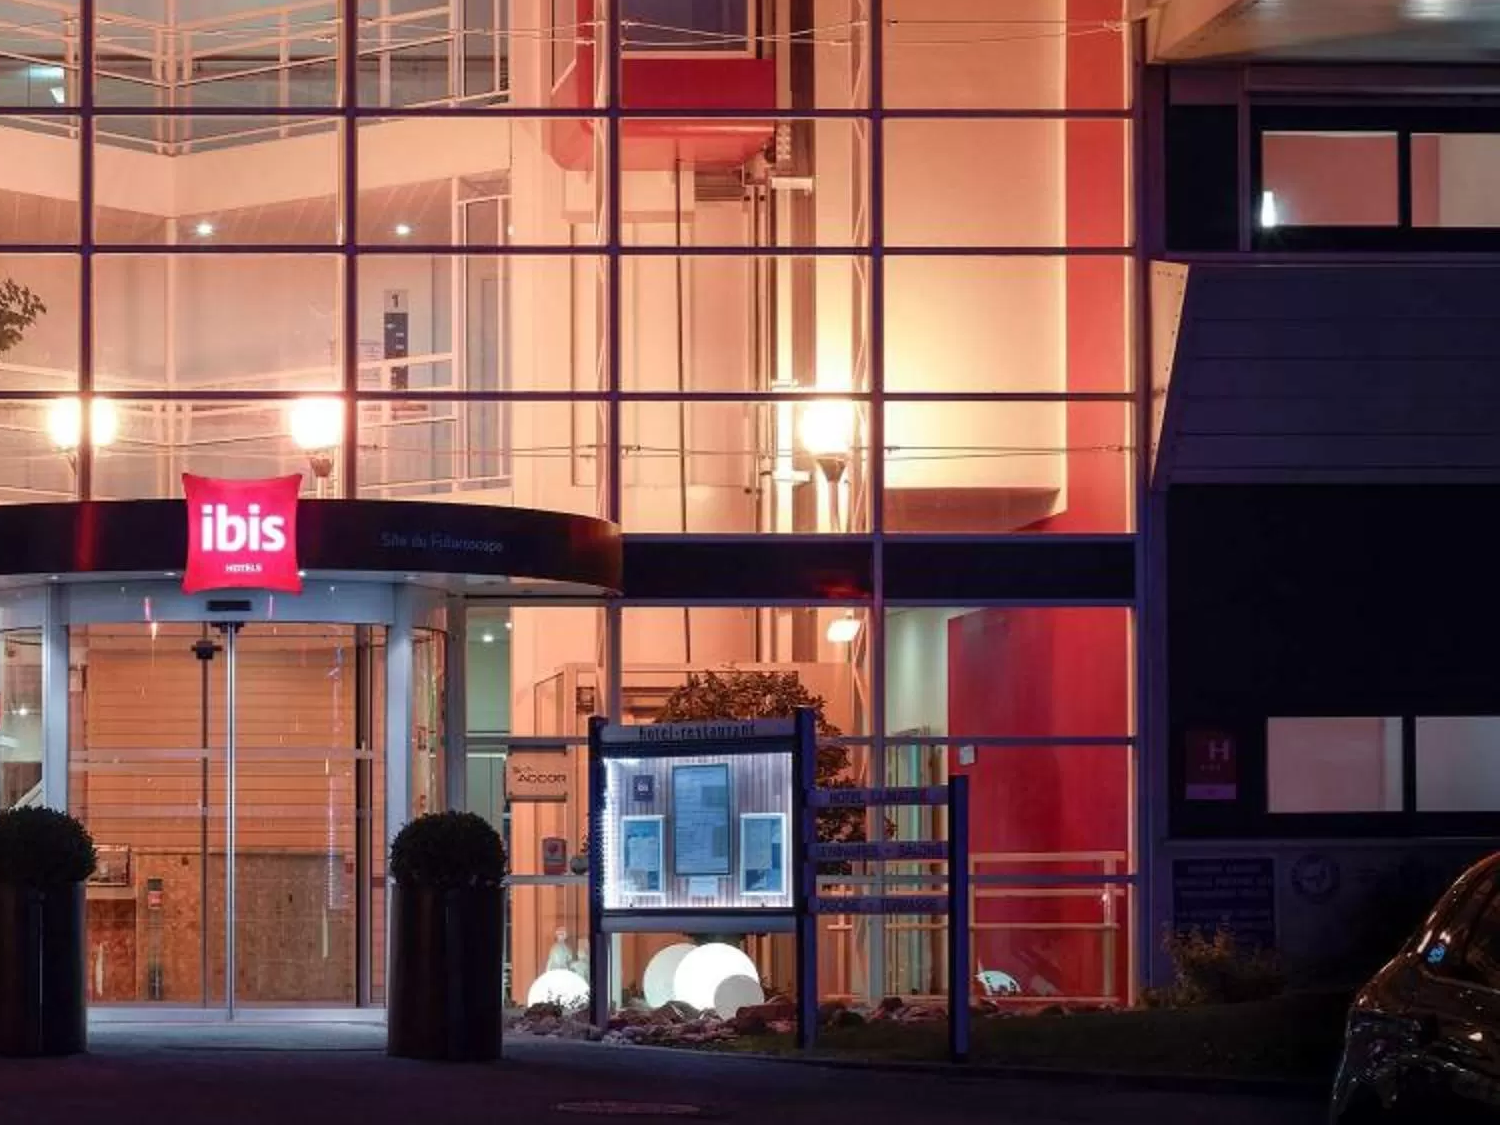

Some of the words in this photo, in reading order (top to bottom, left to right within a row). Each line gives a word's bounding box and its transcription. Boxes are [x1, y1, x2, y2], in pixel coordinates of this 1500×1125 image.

[391, 294, 399, 308] 1
[202, 504, 285, 551] ibis
[225, 562, 263, 573] HOTELS
[1208, 738, 1230, 763] H
[517, 774, 567, 784] ACCOR
